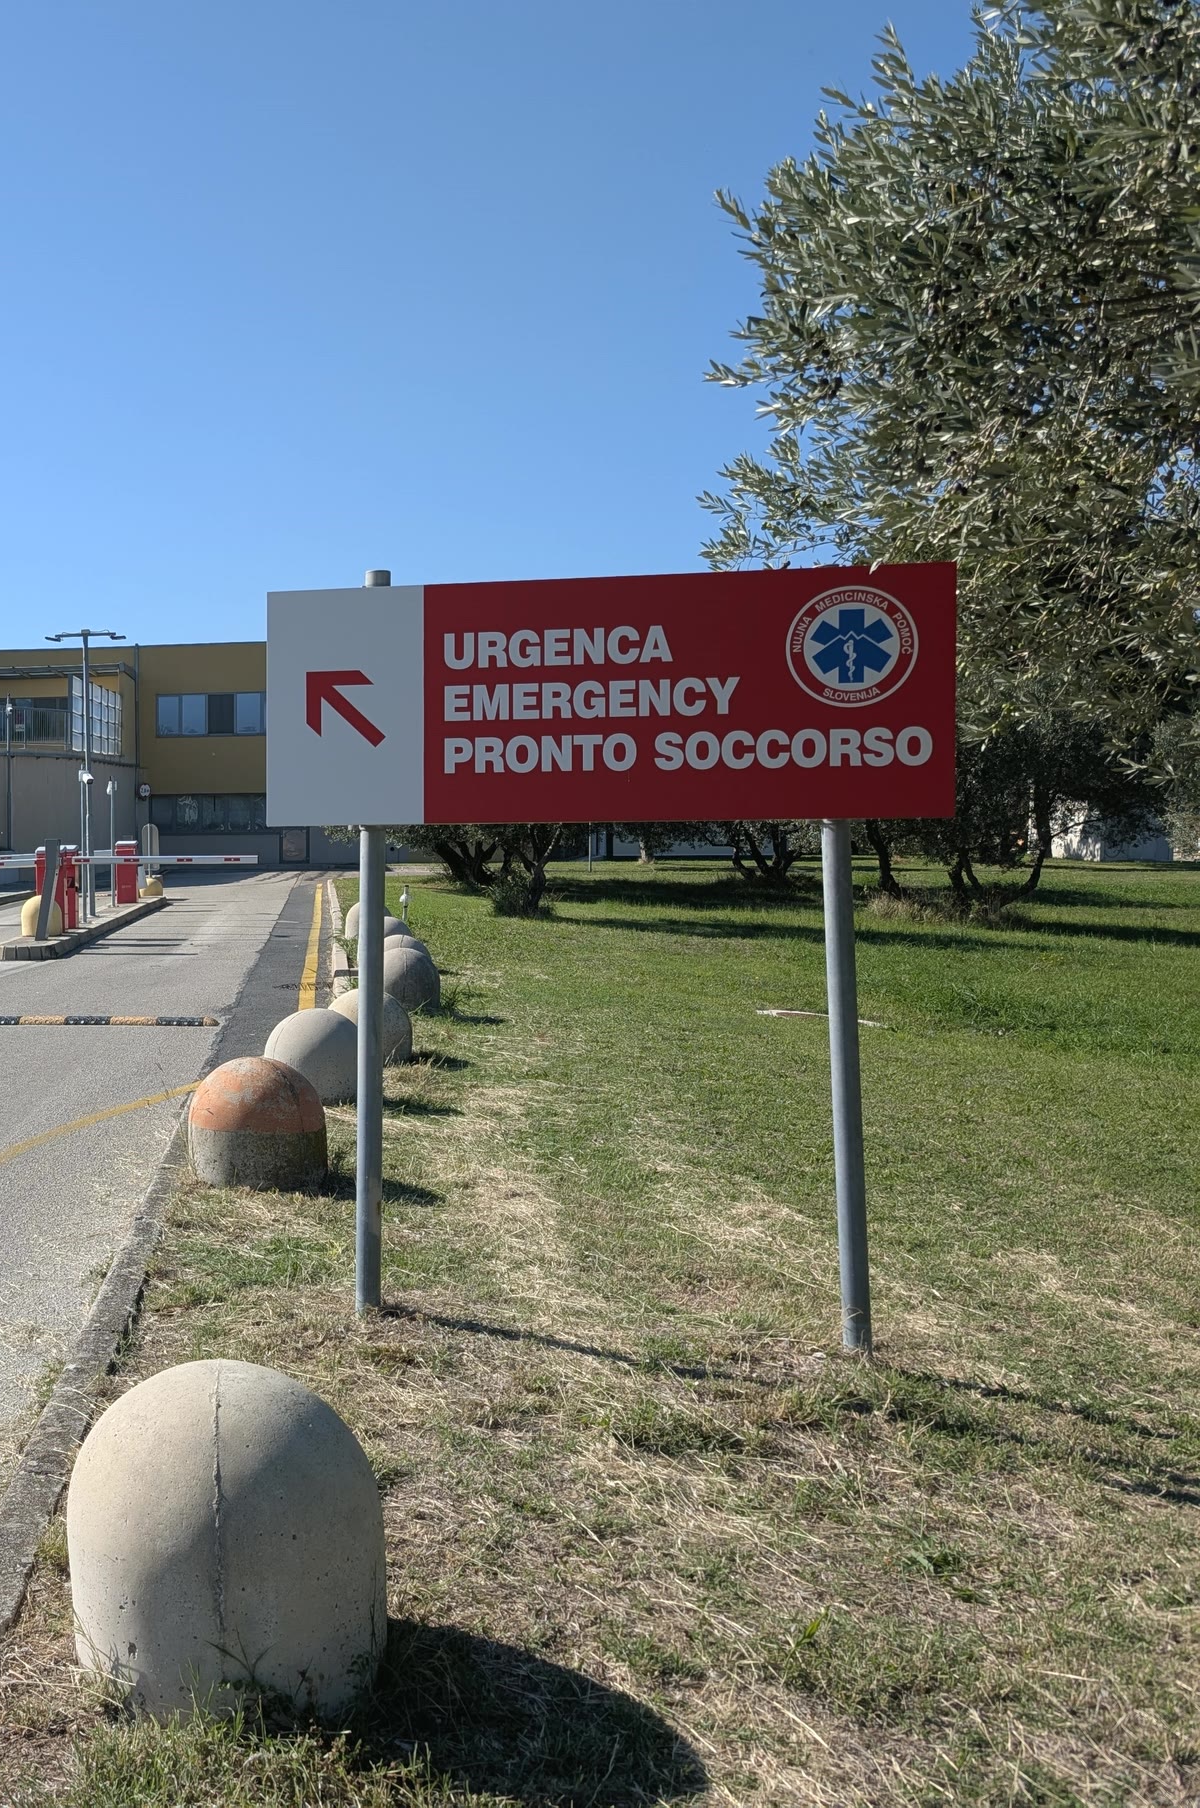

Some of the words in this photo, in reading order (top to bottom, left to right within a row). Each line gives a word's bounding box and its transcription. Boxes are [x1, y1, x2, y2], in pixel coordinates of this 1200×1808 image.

[792, 615, 812, 653] NUJNA
[814, 591, 889, 612] MEDICINSKA
[892, 612, 913, 655] POMOČ
[443, 625, 673, 670] URGENCA
[444, 676, 740, 722] EMERGENCY
[822, 686, 881, 701] SLOVENIJA
[444, 732, 637, 774] PRONTO
[654, 726, 933, 771] SOCCORSO
